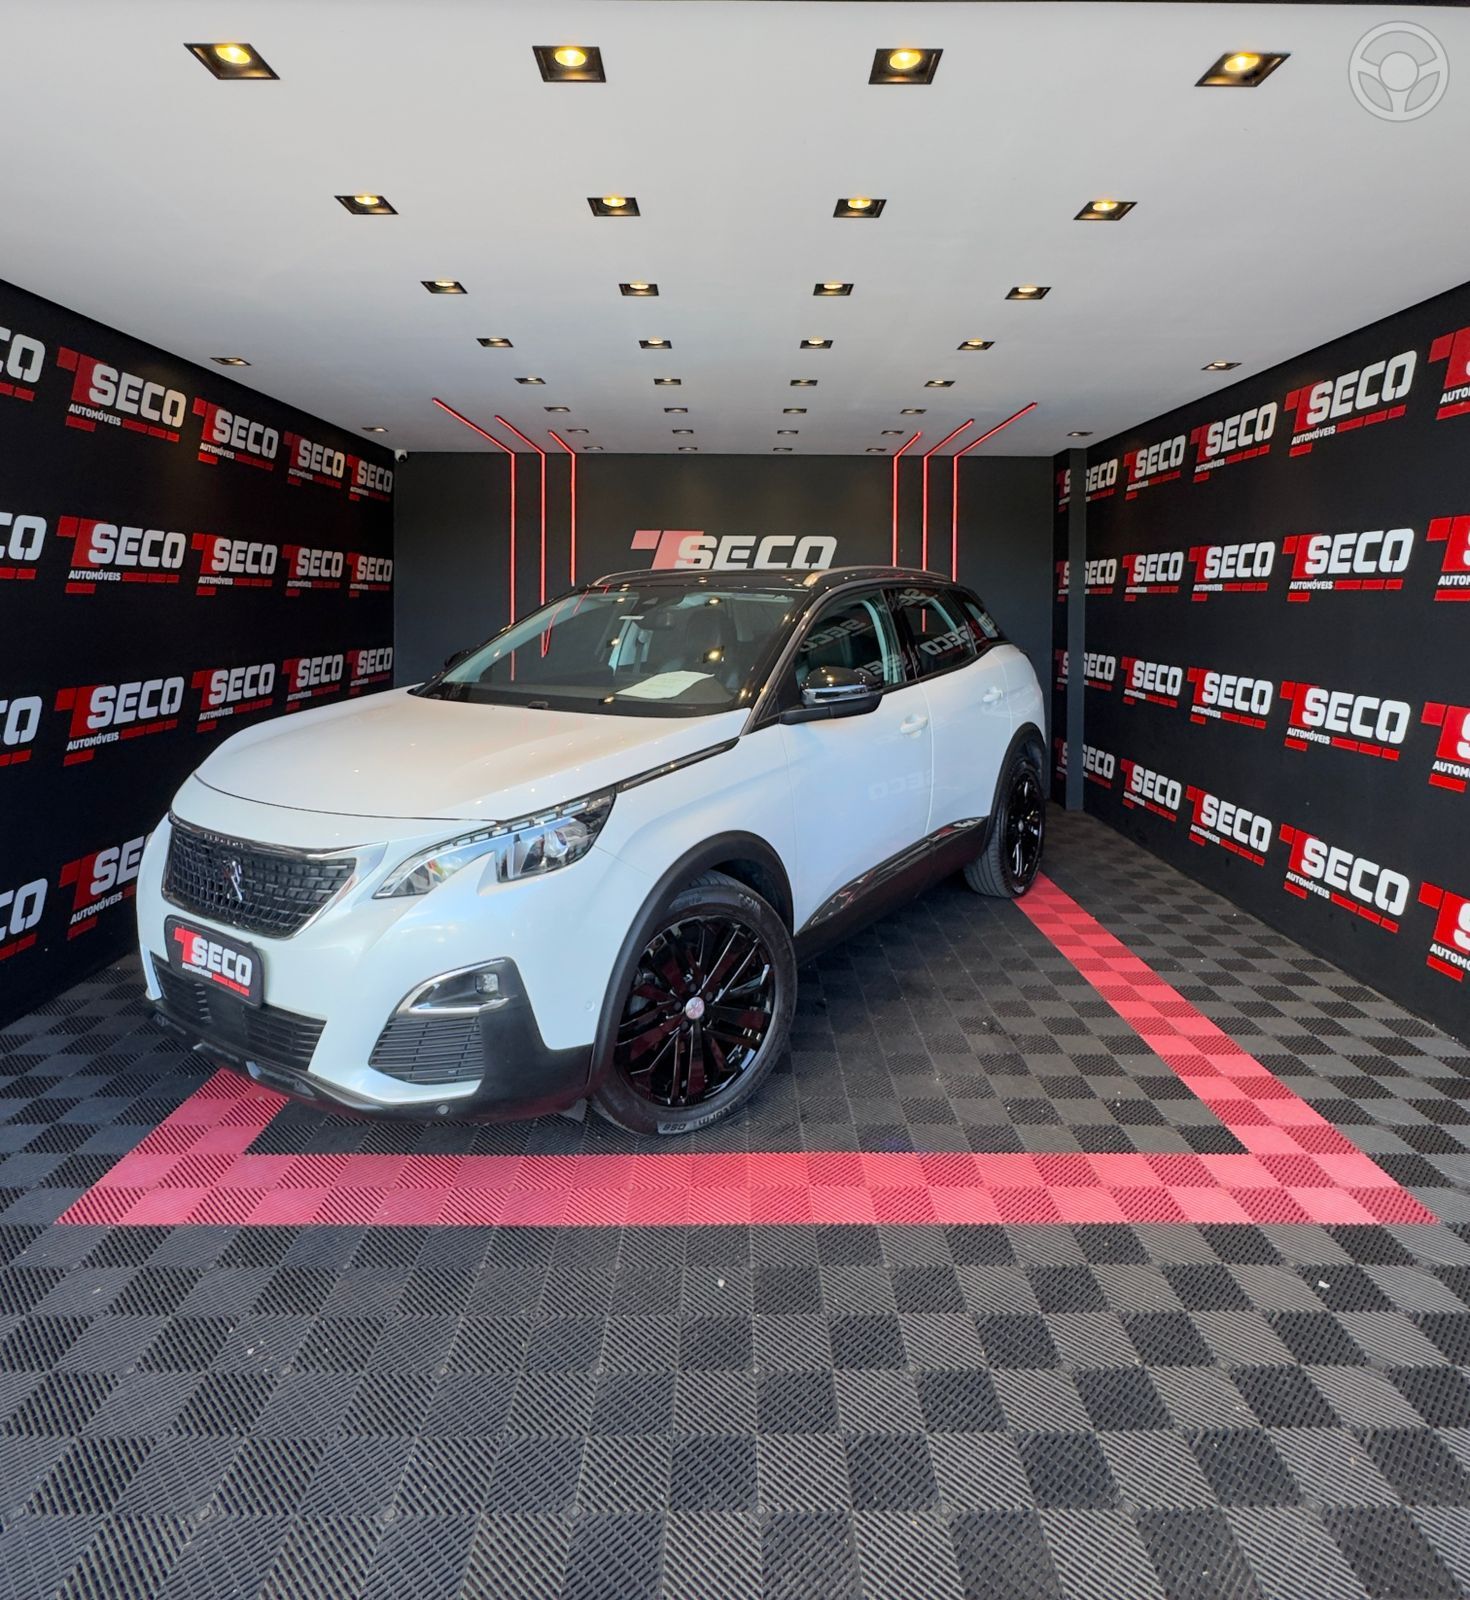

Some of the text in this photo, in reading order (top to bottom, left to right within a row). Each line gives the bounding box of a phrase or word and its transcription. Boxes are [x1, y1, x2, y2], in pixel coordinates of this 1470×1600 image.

[1440, 387, 1470, 405] AUTO
[68, 403, 122, 427] AUTOMÓVEIS
[1292, 425, 1336, 445] AUTOMÓVEIS
[68, 569, 122, 581] AUTOMÓVEIS
[1289, 577, 1333, 590] AUTOMÓVEIS
[66, 732, 119, 751] AUTOMÓVEIS
[1287, 727, 1331, 745] AUTOMÓVEIS
[1432, 760, 1470, 779] AUTOM
[1285, 871, 1330, 899] AUTOMÓVEIS
[70, 891, 123, 925] AUTOMÓVEIS
